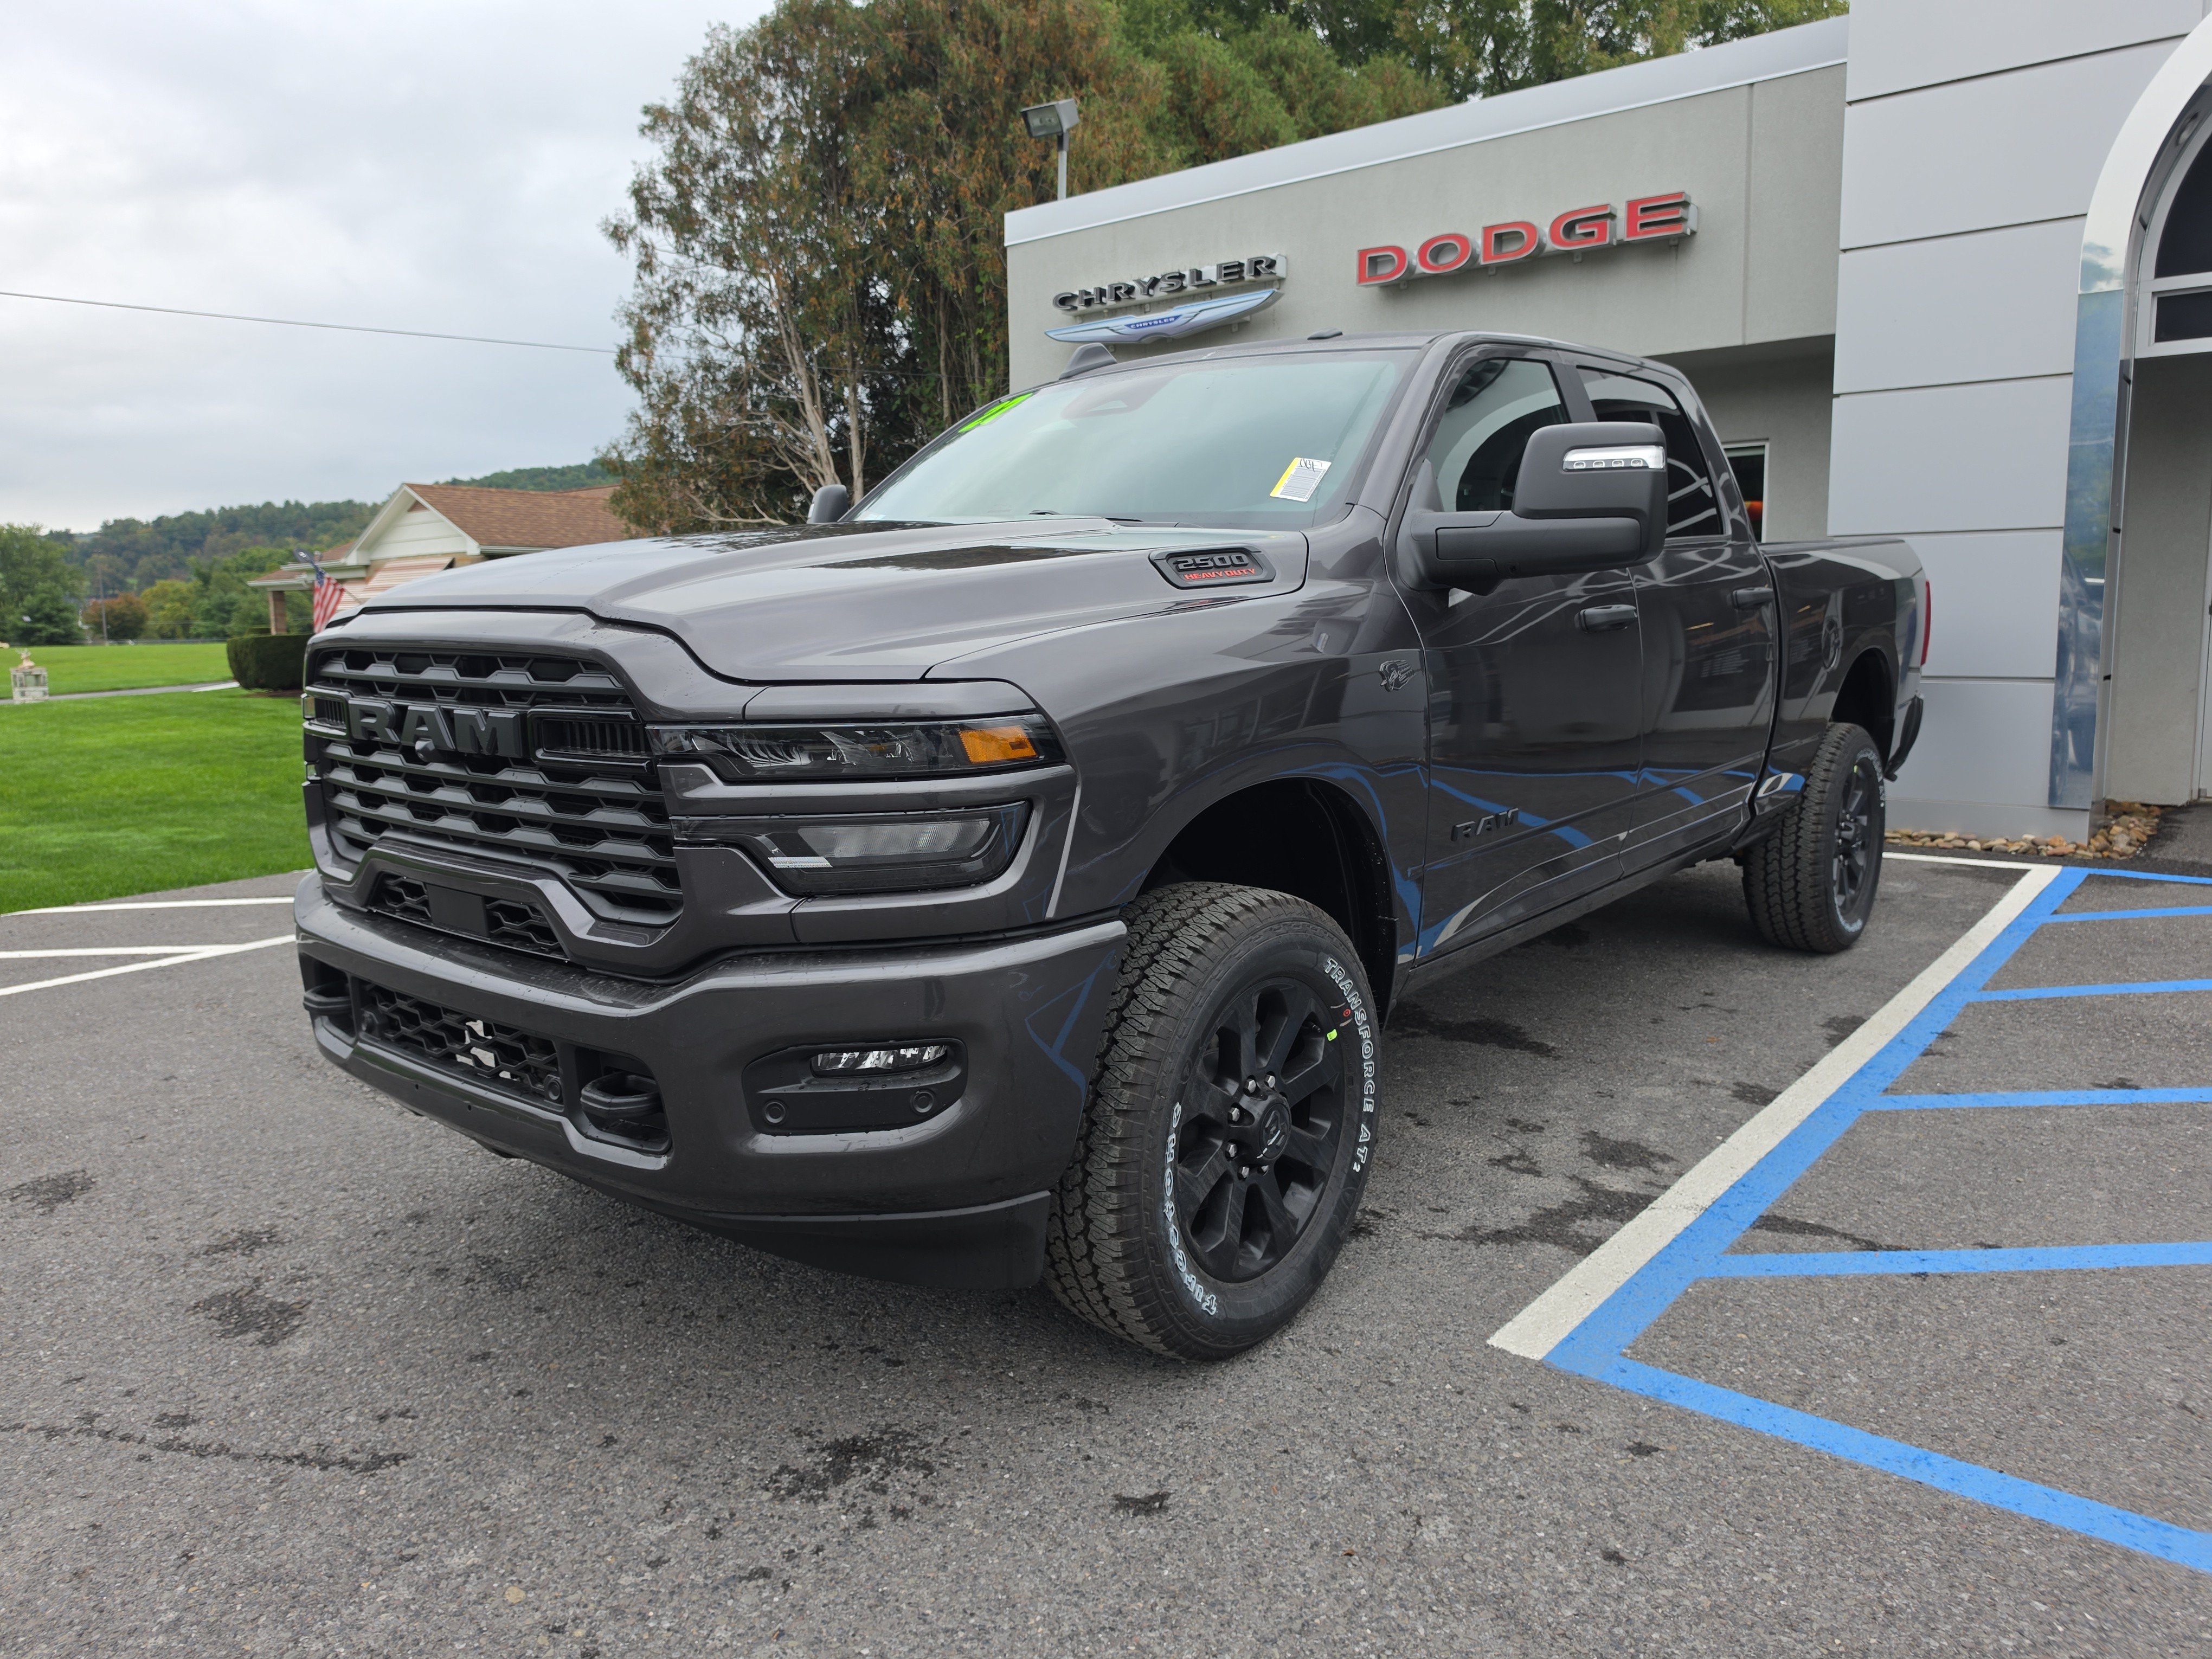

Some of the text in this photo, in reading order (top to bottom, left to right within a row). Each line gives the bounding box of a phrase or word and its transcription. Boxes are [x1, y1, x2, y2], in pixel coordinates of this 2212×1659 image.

[1356, 191, 1690, 286] DODGE
[1051, 255, 1277, 311] CHRYSLER
[1130, 317, 1175, 329] CHRYSLER
[1174, 554, 1249, 572] 2500
[1184, 568, 1256, 581] HEAVY DUTY
[348, 698, 527, 758] RAM
[1450, 808, 1519, 842] RAM
[1323, 956, 1375, 1113] TRANSFORCE
